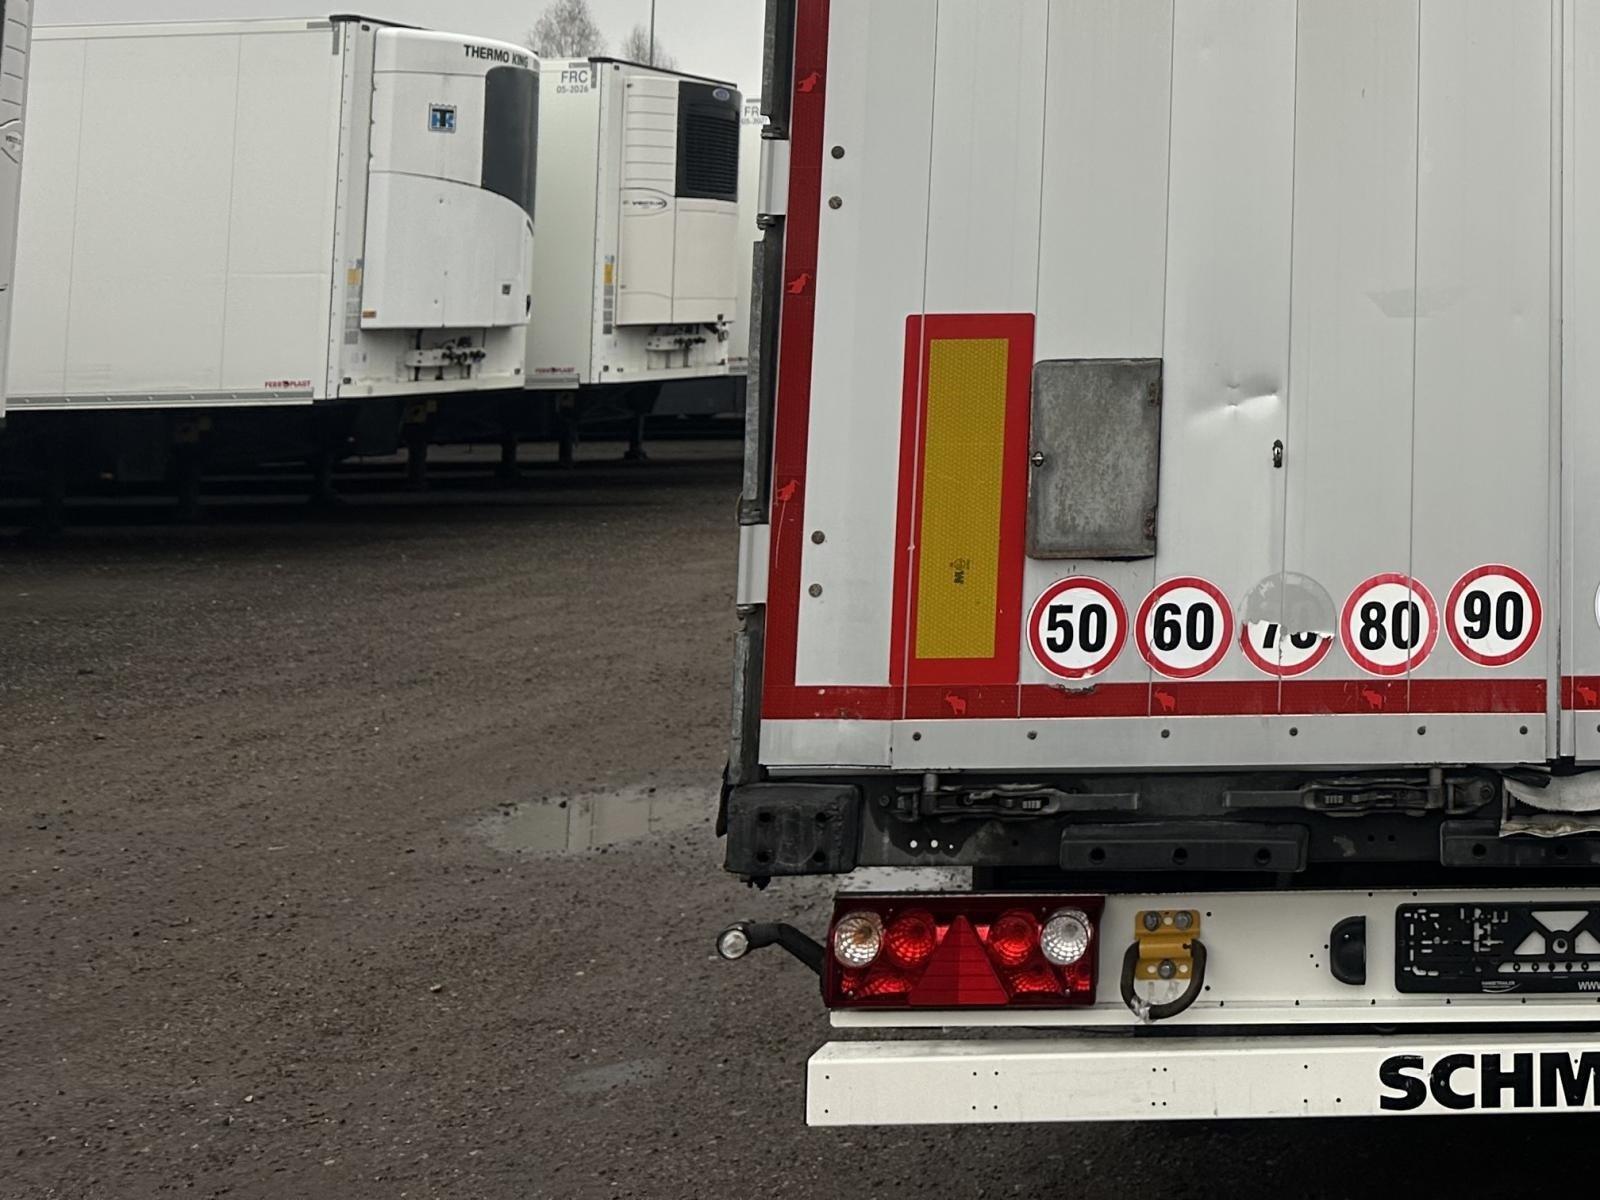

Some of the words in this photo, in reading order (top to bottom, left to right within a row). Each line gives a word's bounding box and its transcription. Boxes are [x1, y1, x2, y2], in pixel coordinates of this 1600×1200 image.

[463, 44, 510, 63] THERMO
[512, 52, 529, 68] KING
[560, 70, 588, 84] FRC
[1046, 603, 1108, 652] 50
[1152, 603, 1214, 650] 60
[1360, 601, 1419, 650] 80
[1463, 590, 1524, 640] 90
